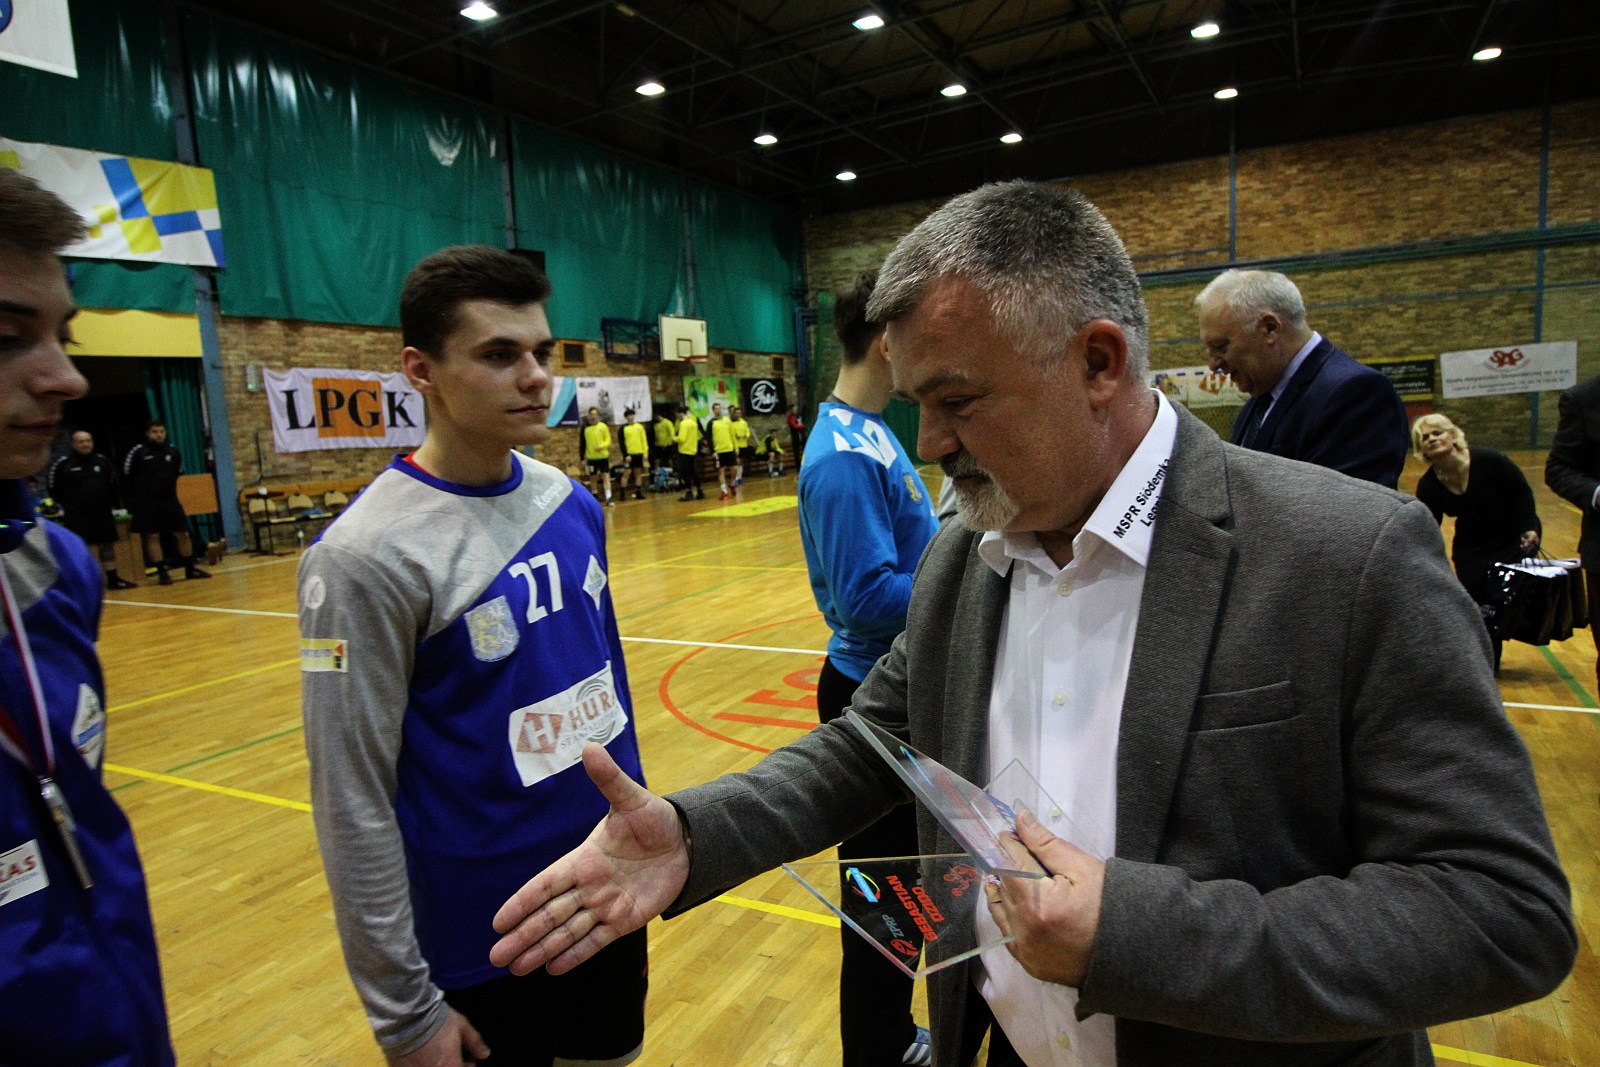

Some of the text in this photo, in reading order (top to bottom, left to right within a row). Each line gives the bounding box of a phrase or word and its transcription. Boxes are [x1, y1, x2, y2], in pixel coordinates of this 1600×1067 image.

[280, 388, 417, 430] LPGK
[1113, 505, 1141, 539] MSPR
[508, 551, 563, 623] 27
[886, 875, 938, 941] SEBASTIAN
[912, 886, 944, 922] DZIDO
[882, 914, 905, 938] ZPRP
